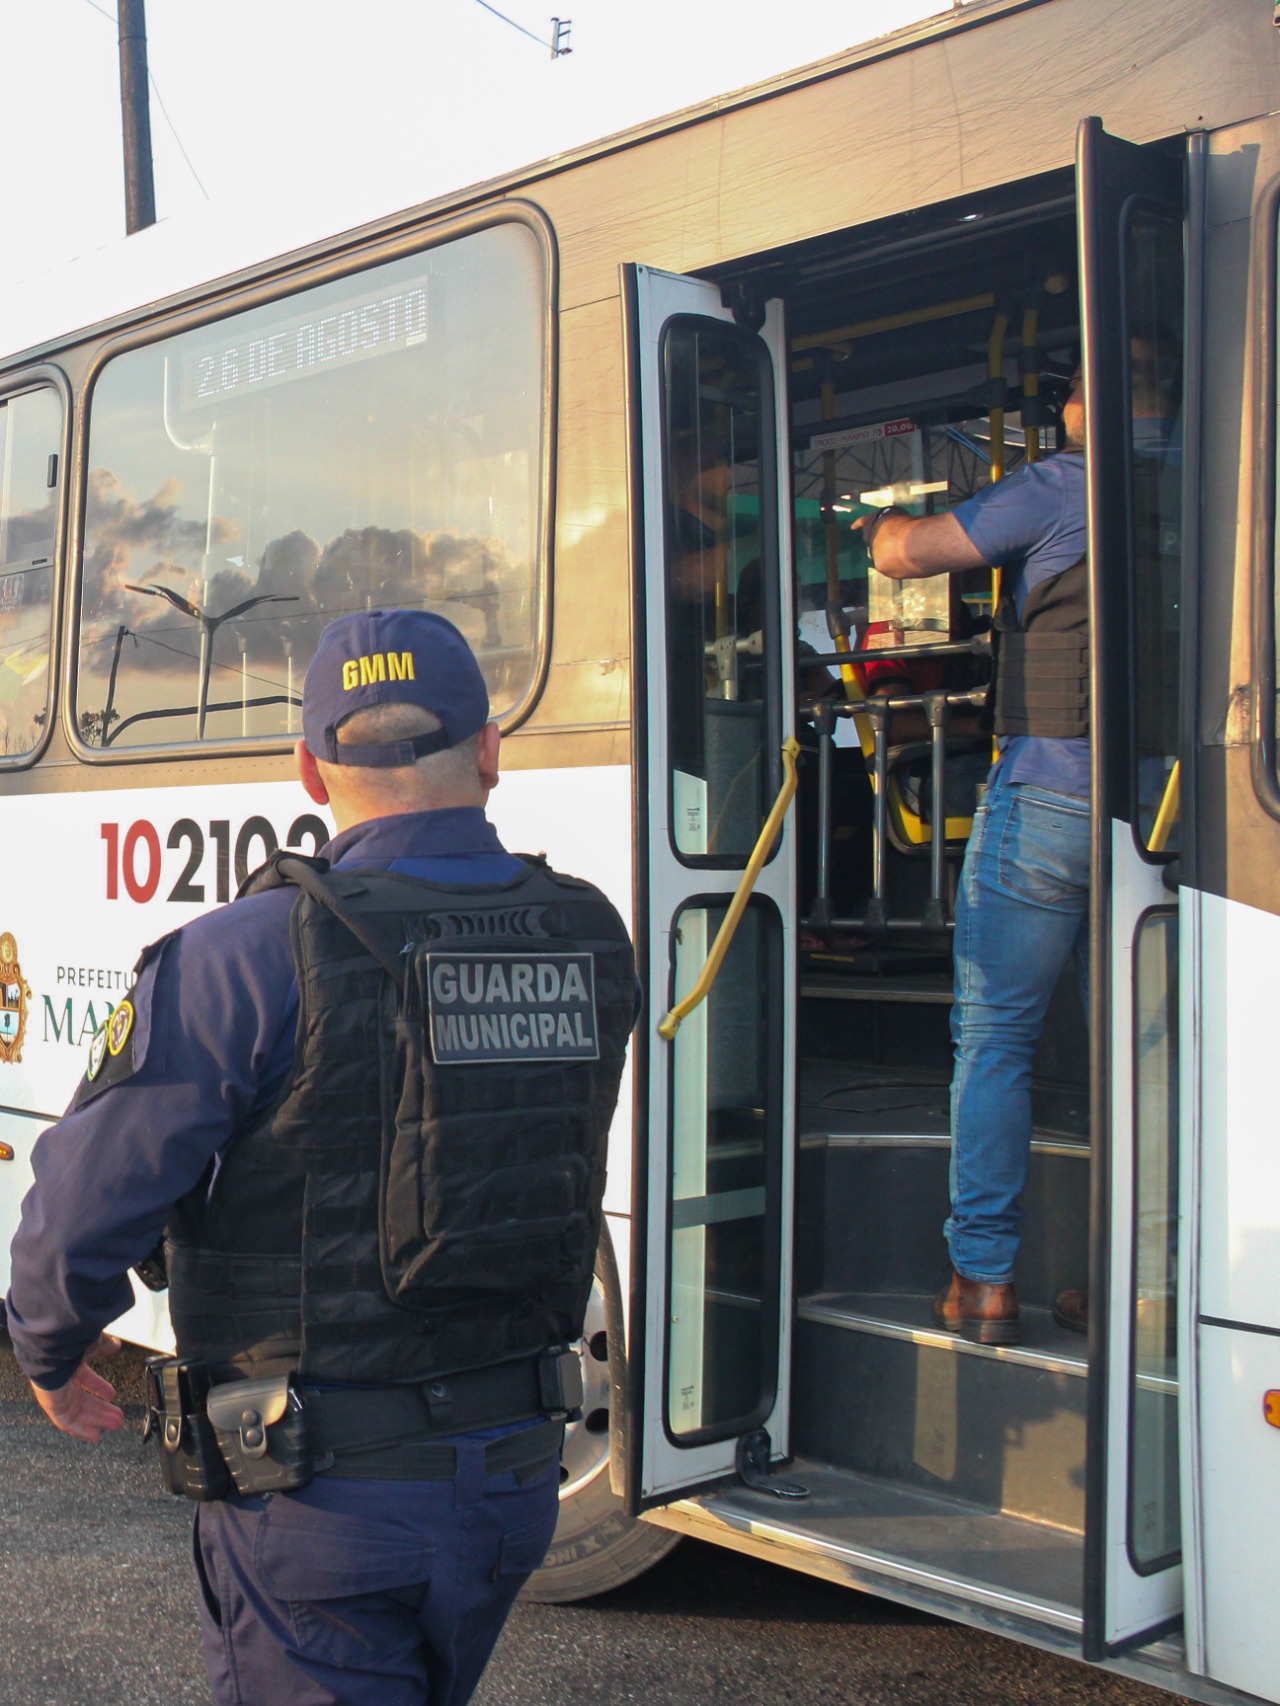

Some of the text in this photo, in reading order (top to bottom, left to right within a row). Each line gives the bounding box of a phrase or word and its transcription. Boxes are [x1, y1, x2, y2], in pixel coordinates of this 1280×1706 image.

[198, 289, 427, 398] 26 DE AGOSTO
[342, 651, 416, 692] GMM
[56, 965, 135, 993] PREFEITU
[432, 962, 590, 1004] GUARDA
[434, 1012, 594, 1052] MUNICIPAL
